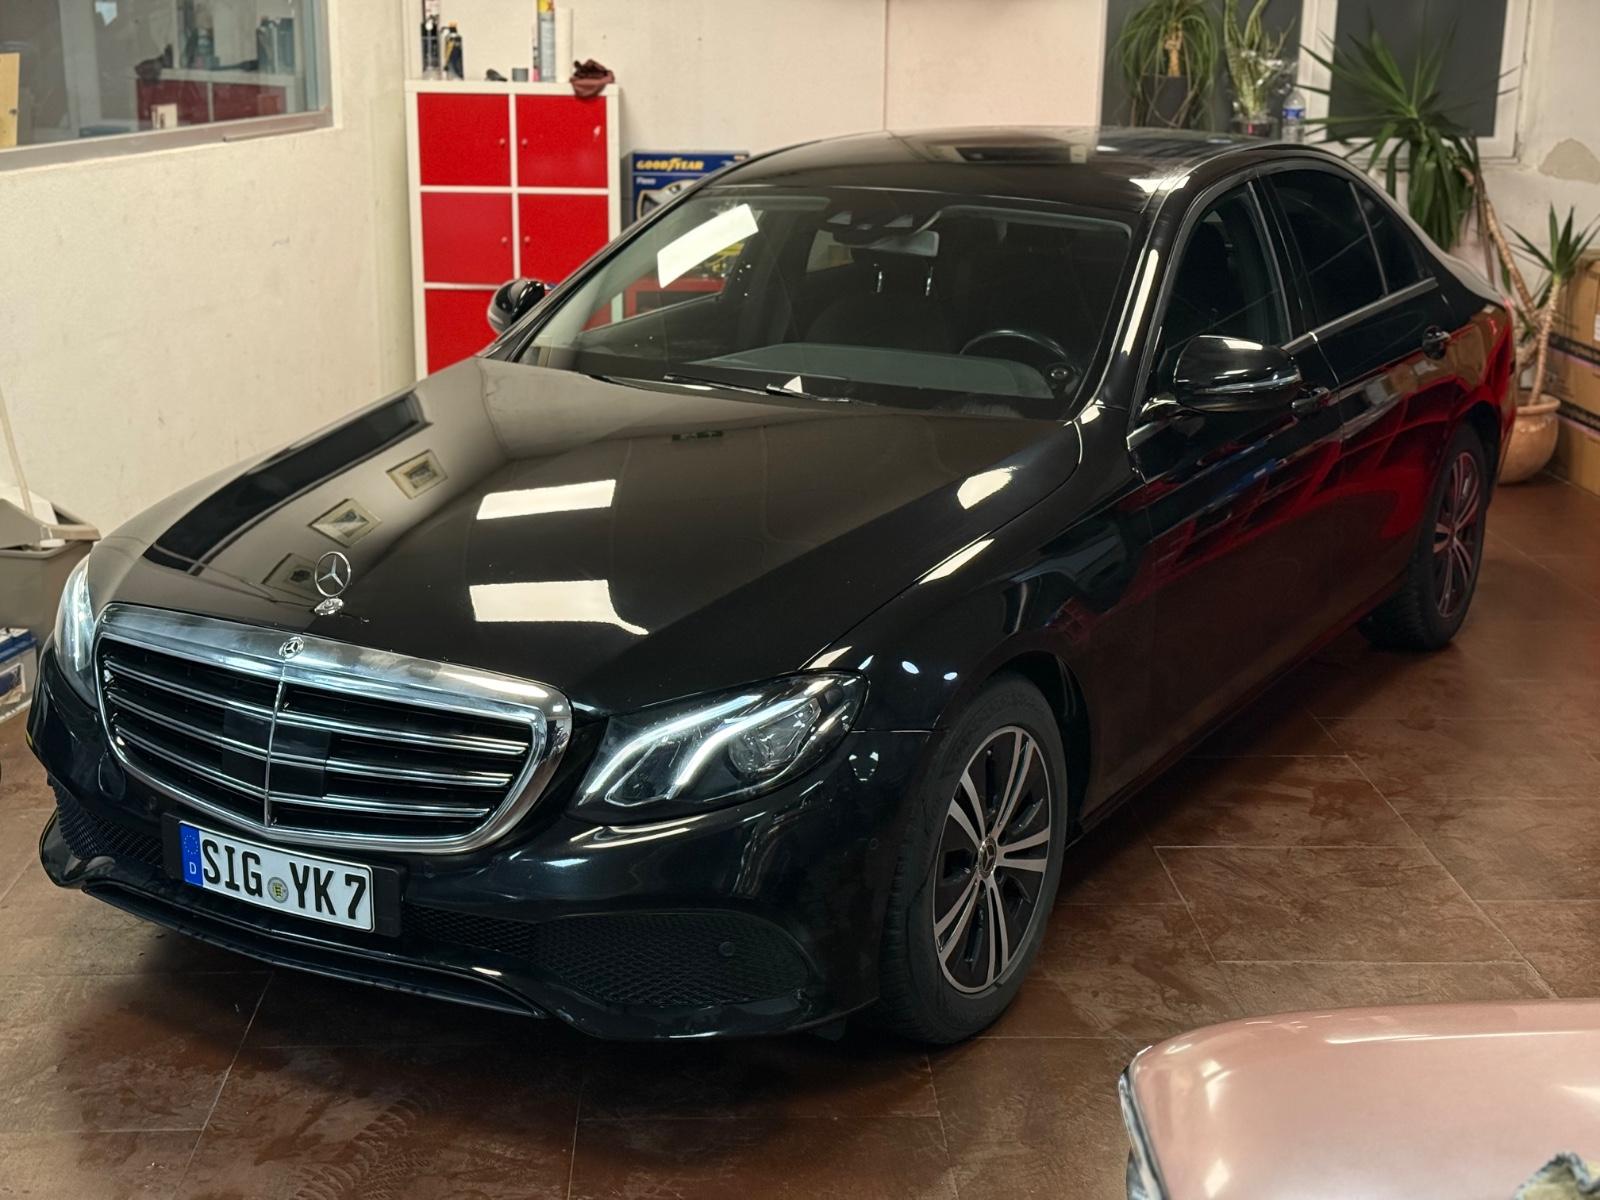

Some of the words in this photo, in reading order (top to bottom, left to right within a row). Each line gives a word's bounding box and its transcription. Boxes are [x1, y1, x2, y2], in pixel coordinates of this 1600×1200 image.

[636, 157, 705, 172] GOODYEAR
[188, 861, 197, 875] D
[202, 839, 263, 898] SIG
[289, 862, 336, 915] YK
[344, 873, 367, 920] 7
